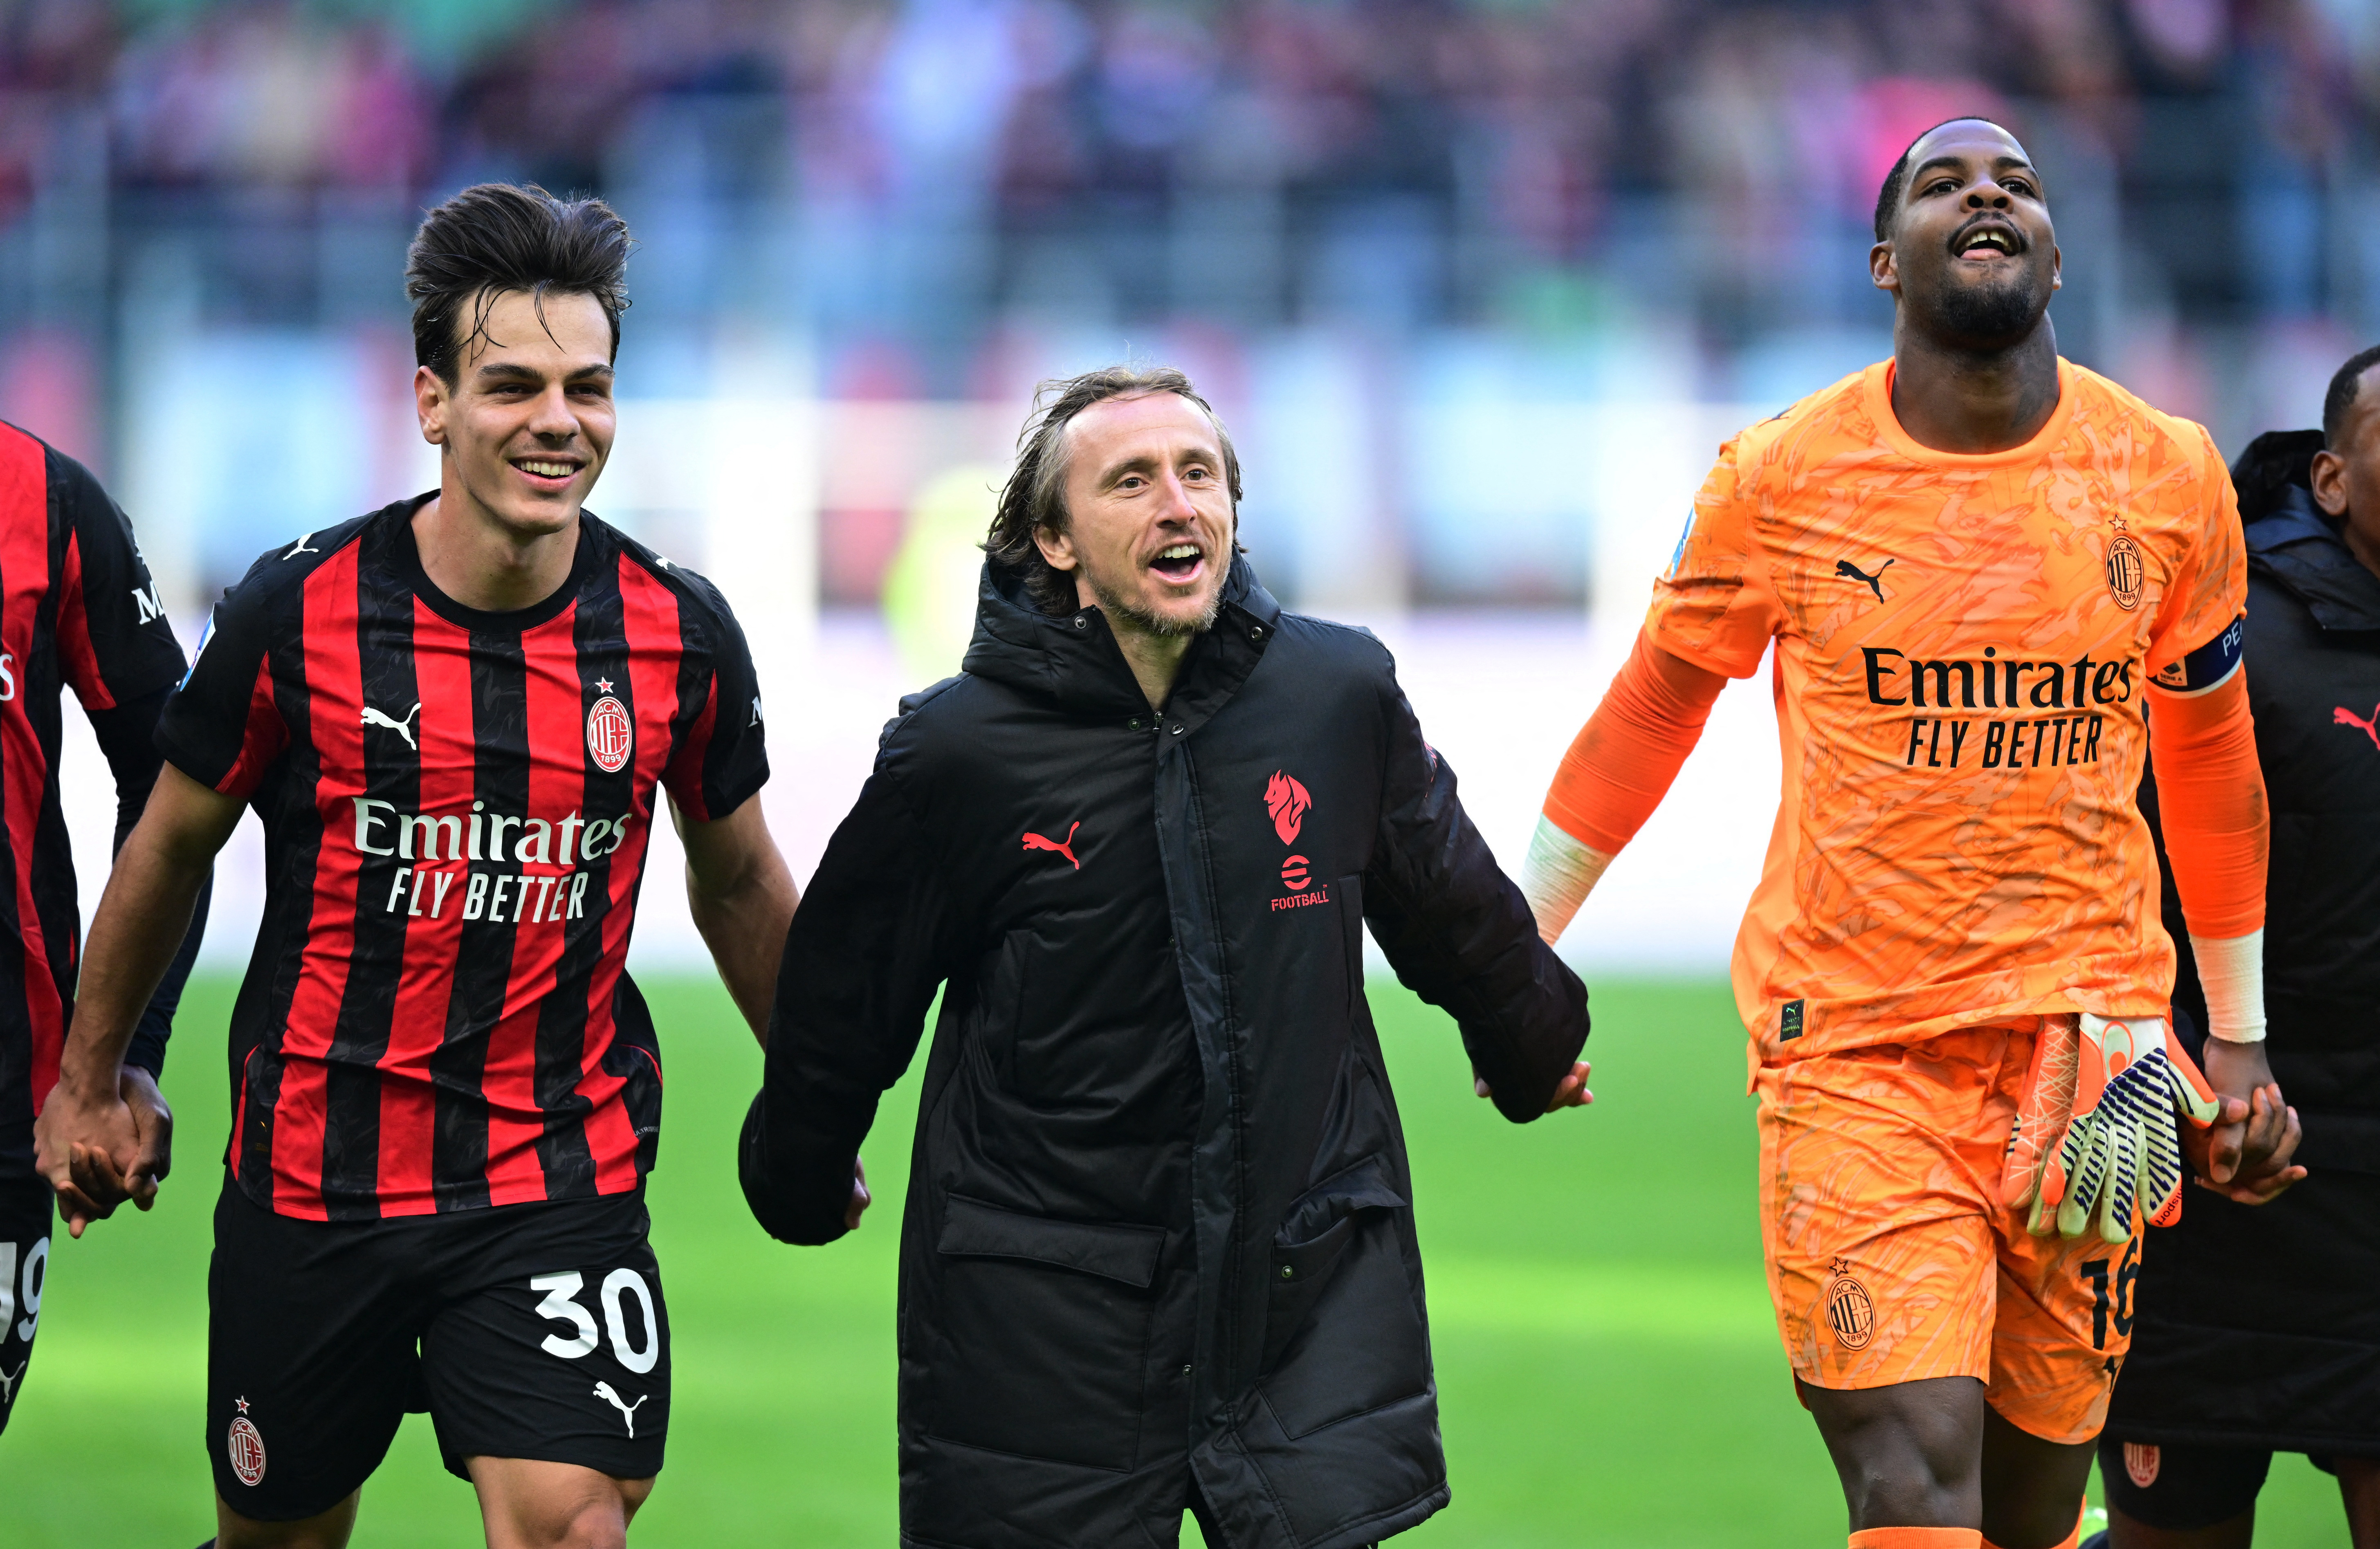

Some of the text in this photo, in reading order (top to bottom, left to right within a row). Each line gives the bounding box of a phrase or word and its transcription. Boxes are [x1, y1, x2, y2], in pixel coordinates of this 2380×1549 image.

[2112, 541, 2133, 555] ACM
[2119, 593, 2135, 601] 1899
[2223, 621, 2242, 657] PE
[1861, 646, 2135, 708] Emirates
[596, 703, 620, 717] ACM
[1906, 715, 2103, 769] FLY BETTER
[601, 754, 621, 763] 1899
[351, 796, 632, 865] Emirates
[386, 866, 589, 923] FLY BETTER
[1271, 890, 1329, 911] FOOTBALL
[1835, 1283, 1859, 1299] ACM
[2081, 1236, 2140, 1350] 16
[530, 1268, 658, 1374] 30
[1846, 1331, 1868, 1342] 1899
[235, 1423, 254, 1437] ACM
[240, 1468, 257, 1478] 1899
